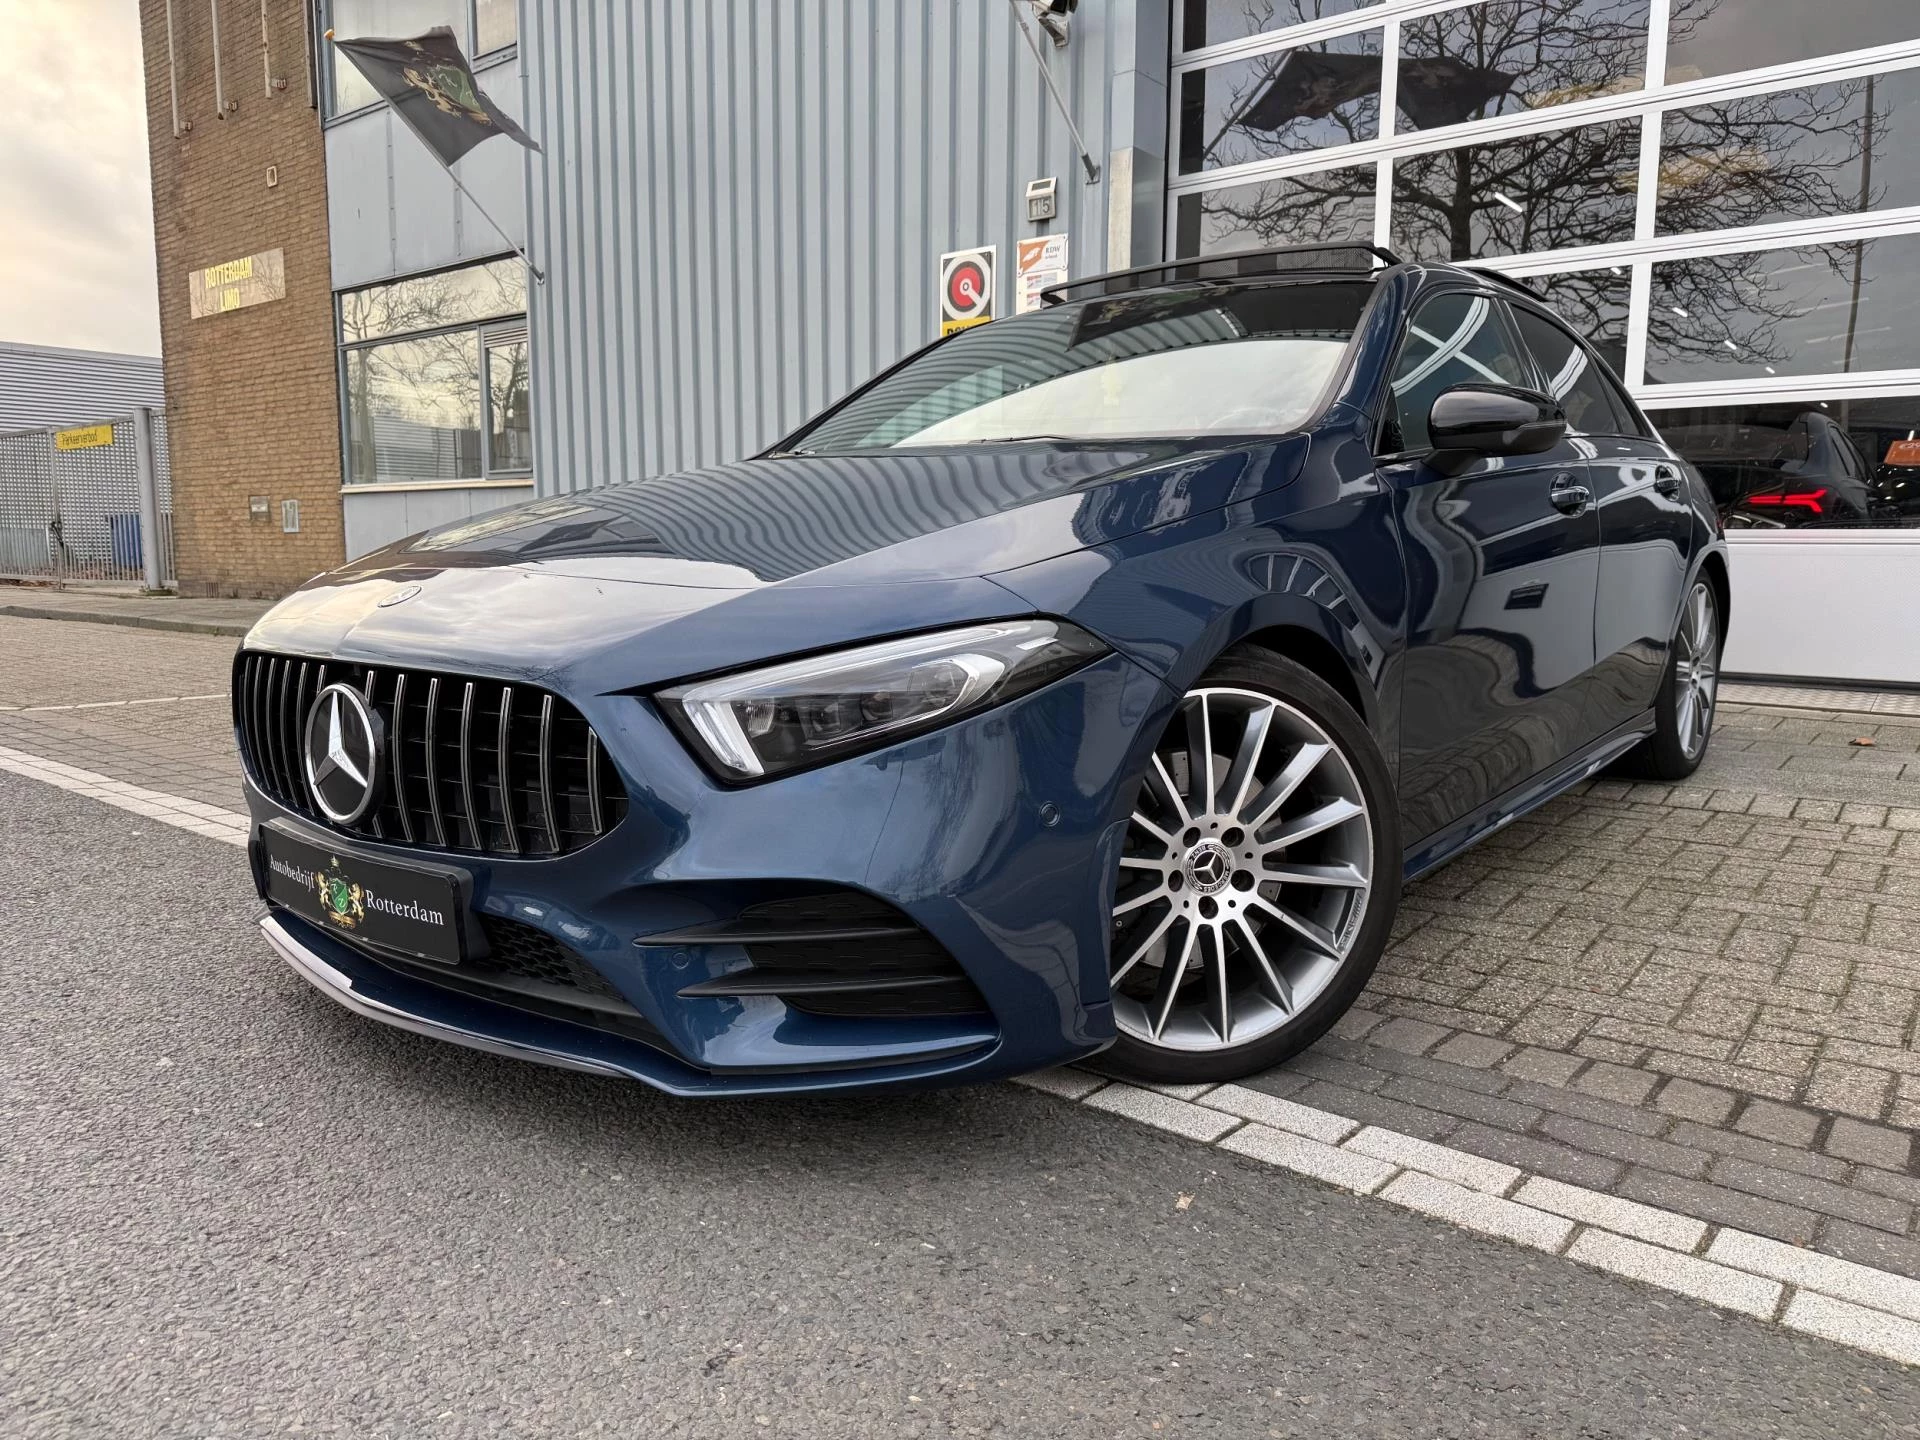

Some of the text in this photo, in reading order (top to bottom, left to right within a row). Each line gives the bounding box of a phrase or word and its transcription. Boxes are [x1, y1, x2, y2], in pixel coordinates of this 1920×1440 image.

[204, 255, 253, 289] ROTTERDAM
[219, 287, 241, 312] LIMO
[269, 853, 445, 926] Autobedrijf Rotterdam
[1202, 870, 1231, 893] MERCEDES
